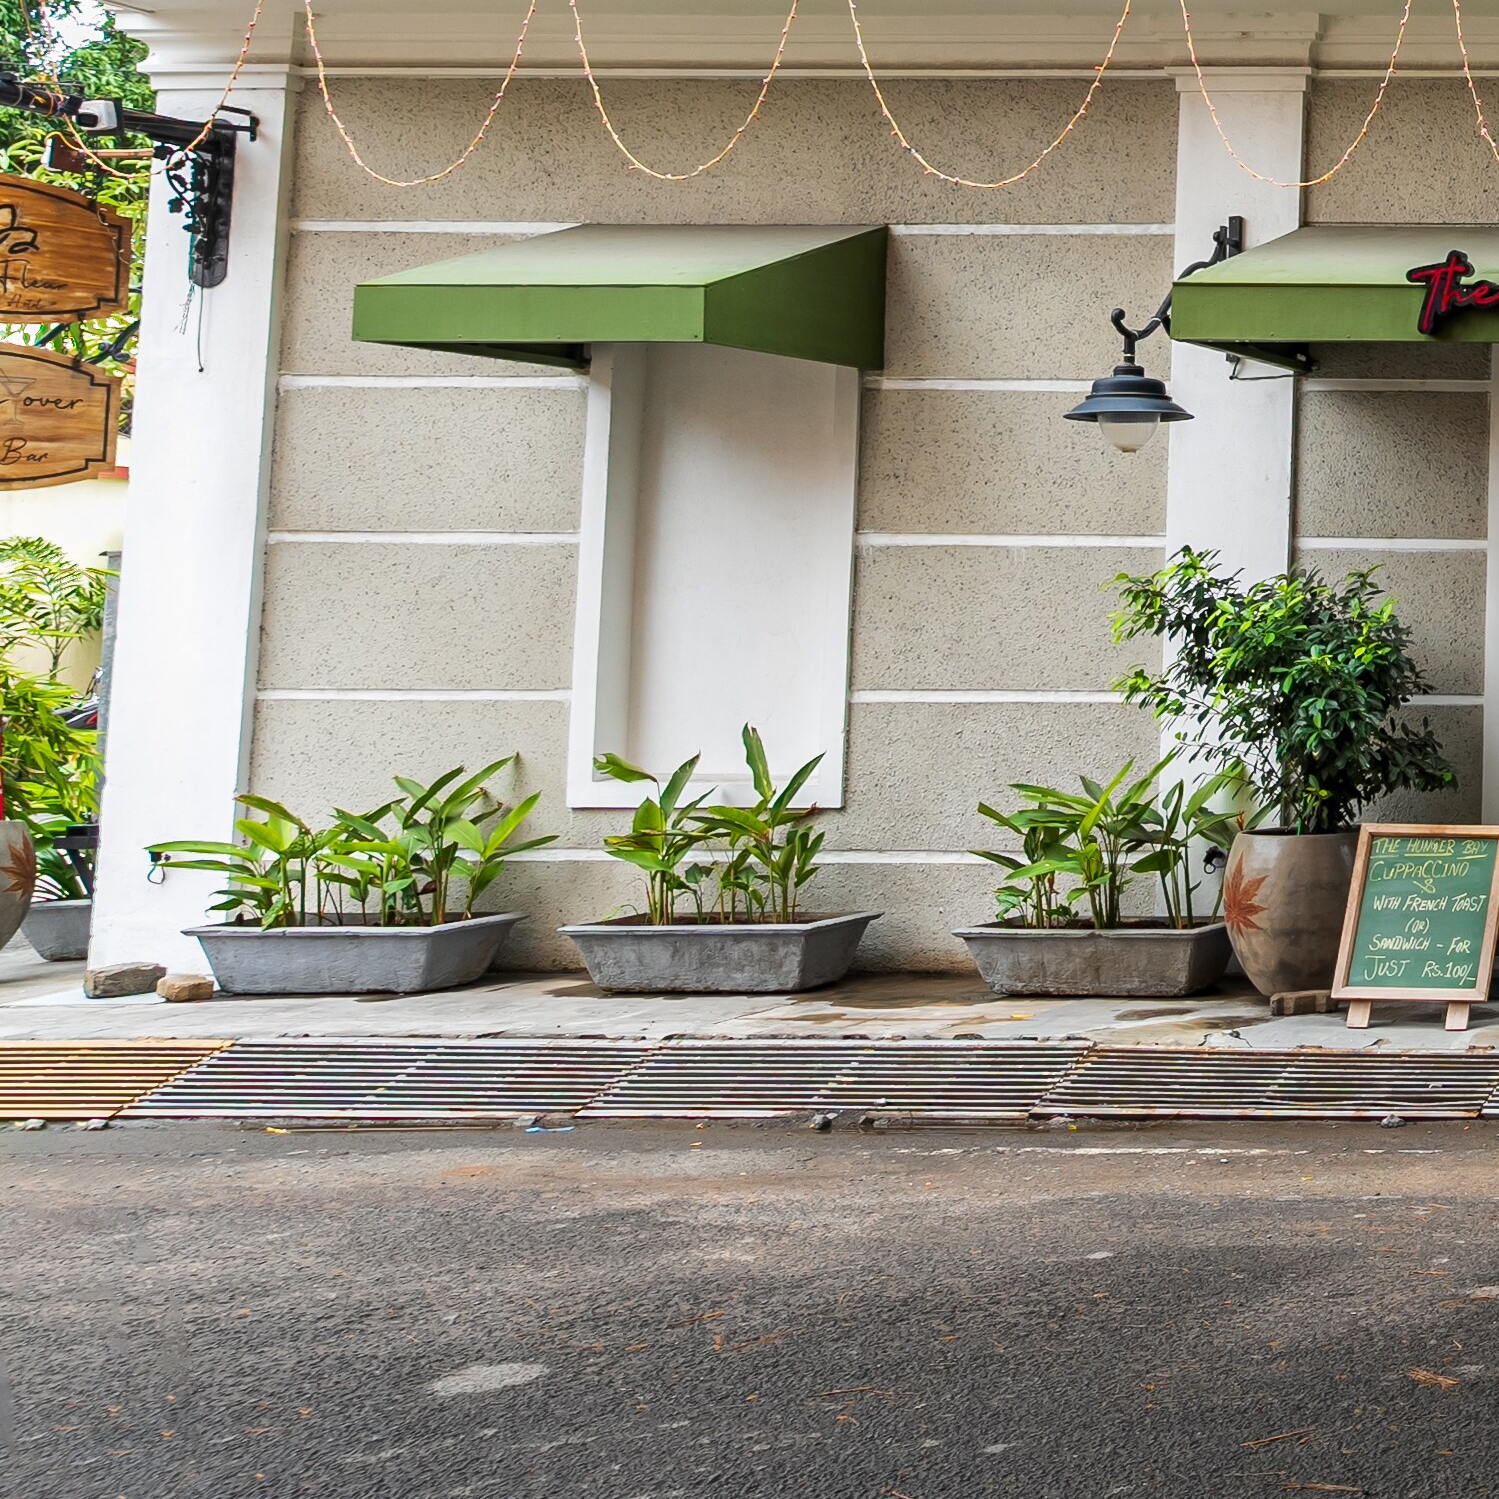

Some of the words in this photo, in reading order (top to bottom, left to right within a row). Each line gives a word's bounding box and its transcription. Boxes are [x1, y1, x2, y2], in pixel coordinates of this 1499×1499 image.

[1372, 838, 1400, 854] THE
[1462, 840, 1489, 854] BAY
[1374, 895, 1401, 911] WITH
[1403, 894, 1448, 911] FRENCH
[1452, 893, 1487, 912] TOAST
[1405, 918, 1429, 934] (OR)
[1369, 934, 1429, 951] SANDWICH
[1447, 937, 1471, 955] FOR
[1364, 955, 1410, 980] JUST
